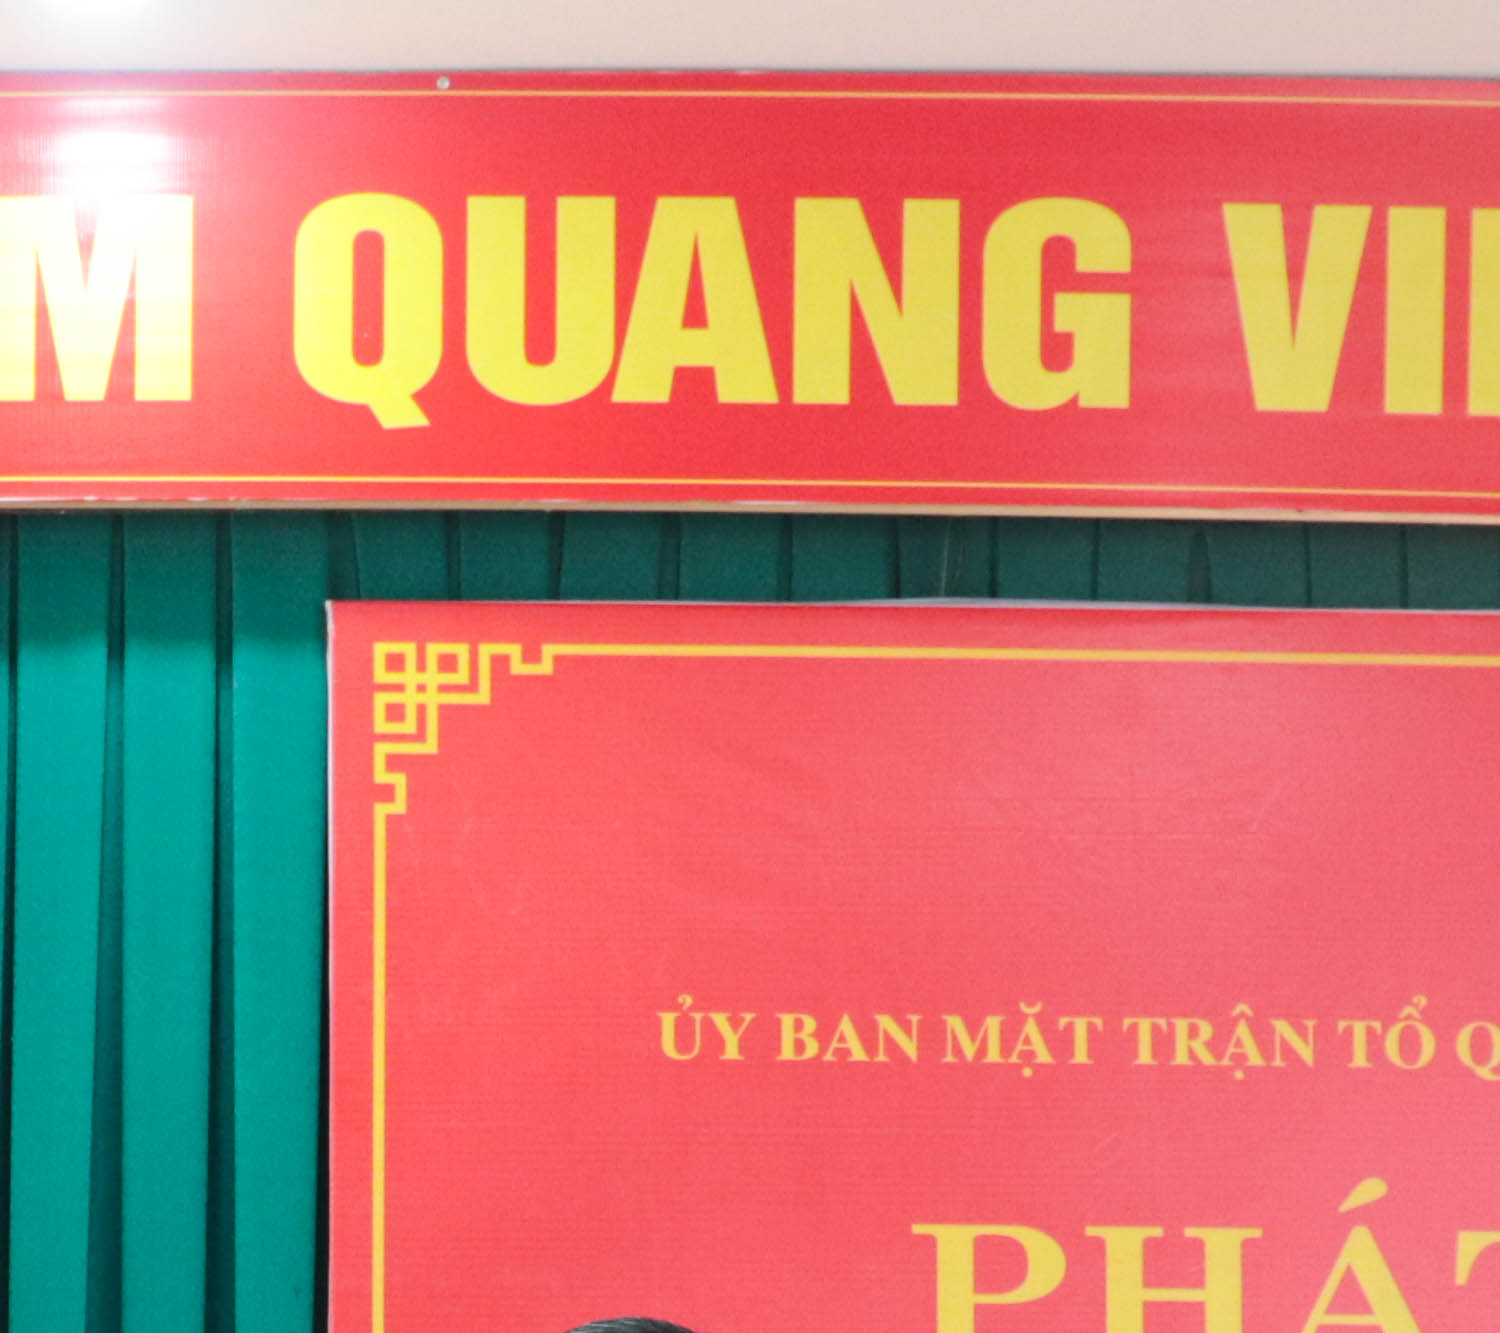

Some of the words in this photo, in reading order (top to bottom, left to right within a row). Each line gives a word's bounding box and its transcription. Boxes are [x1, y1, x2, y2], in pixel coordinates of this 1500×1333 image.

[290, 195, 1134, 432] QUANG
[657, 994, 755, 1064] ỦY
[775, 1010, 923, 1064] BAN
[941, 1002, 1102, 1079] MẶT
[1123, 1002, 1317, 1079] TRẬN
[1337, 994, 1437, 1071] TỔ
